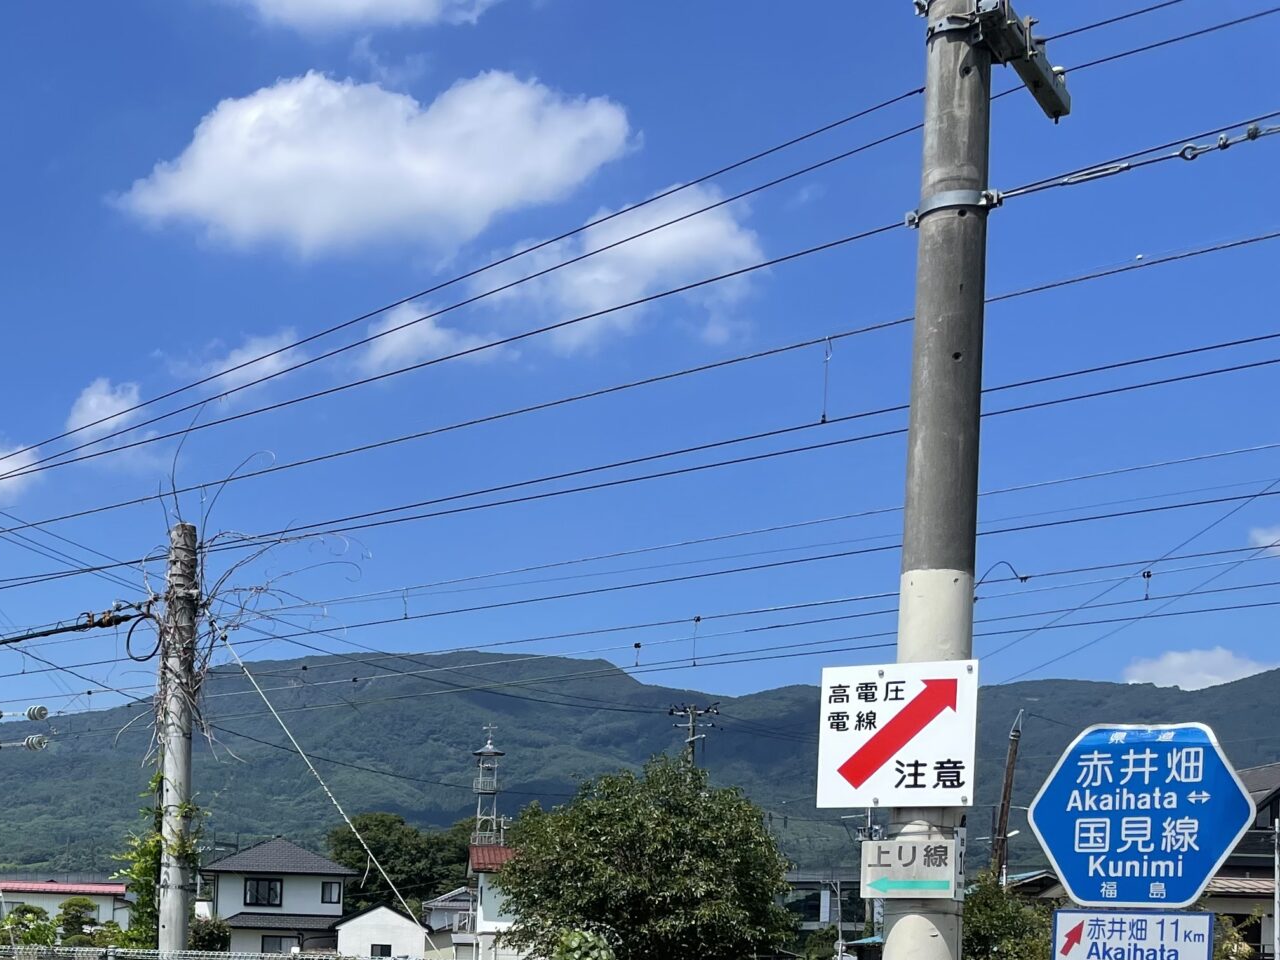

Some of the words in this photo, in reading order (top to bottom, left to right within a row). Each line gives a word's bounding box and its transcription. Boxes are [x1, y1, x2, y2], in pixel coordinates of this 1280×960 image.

[828, 680, 906, 704] 高電圧
[827, 710, 877, 732] 電線
[1108, 731, 1176, 744] 県道
[894, 758, 966, 789] 注意
[1076, 747, 1204, 787] 赤井畑
[1066, 787, 1178, 811] Akaihata
[1074, 816, 1199, 853] 国見線
[867, 845, 949, 868] 上り線
[1088, 855, 1183, 877] Kunimi
[1100, 881, 1167, 899] 福島
[1087, 917, 1148, 941] 赤井畑
